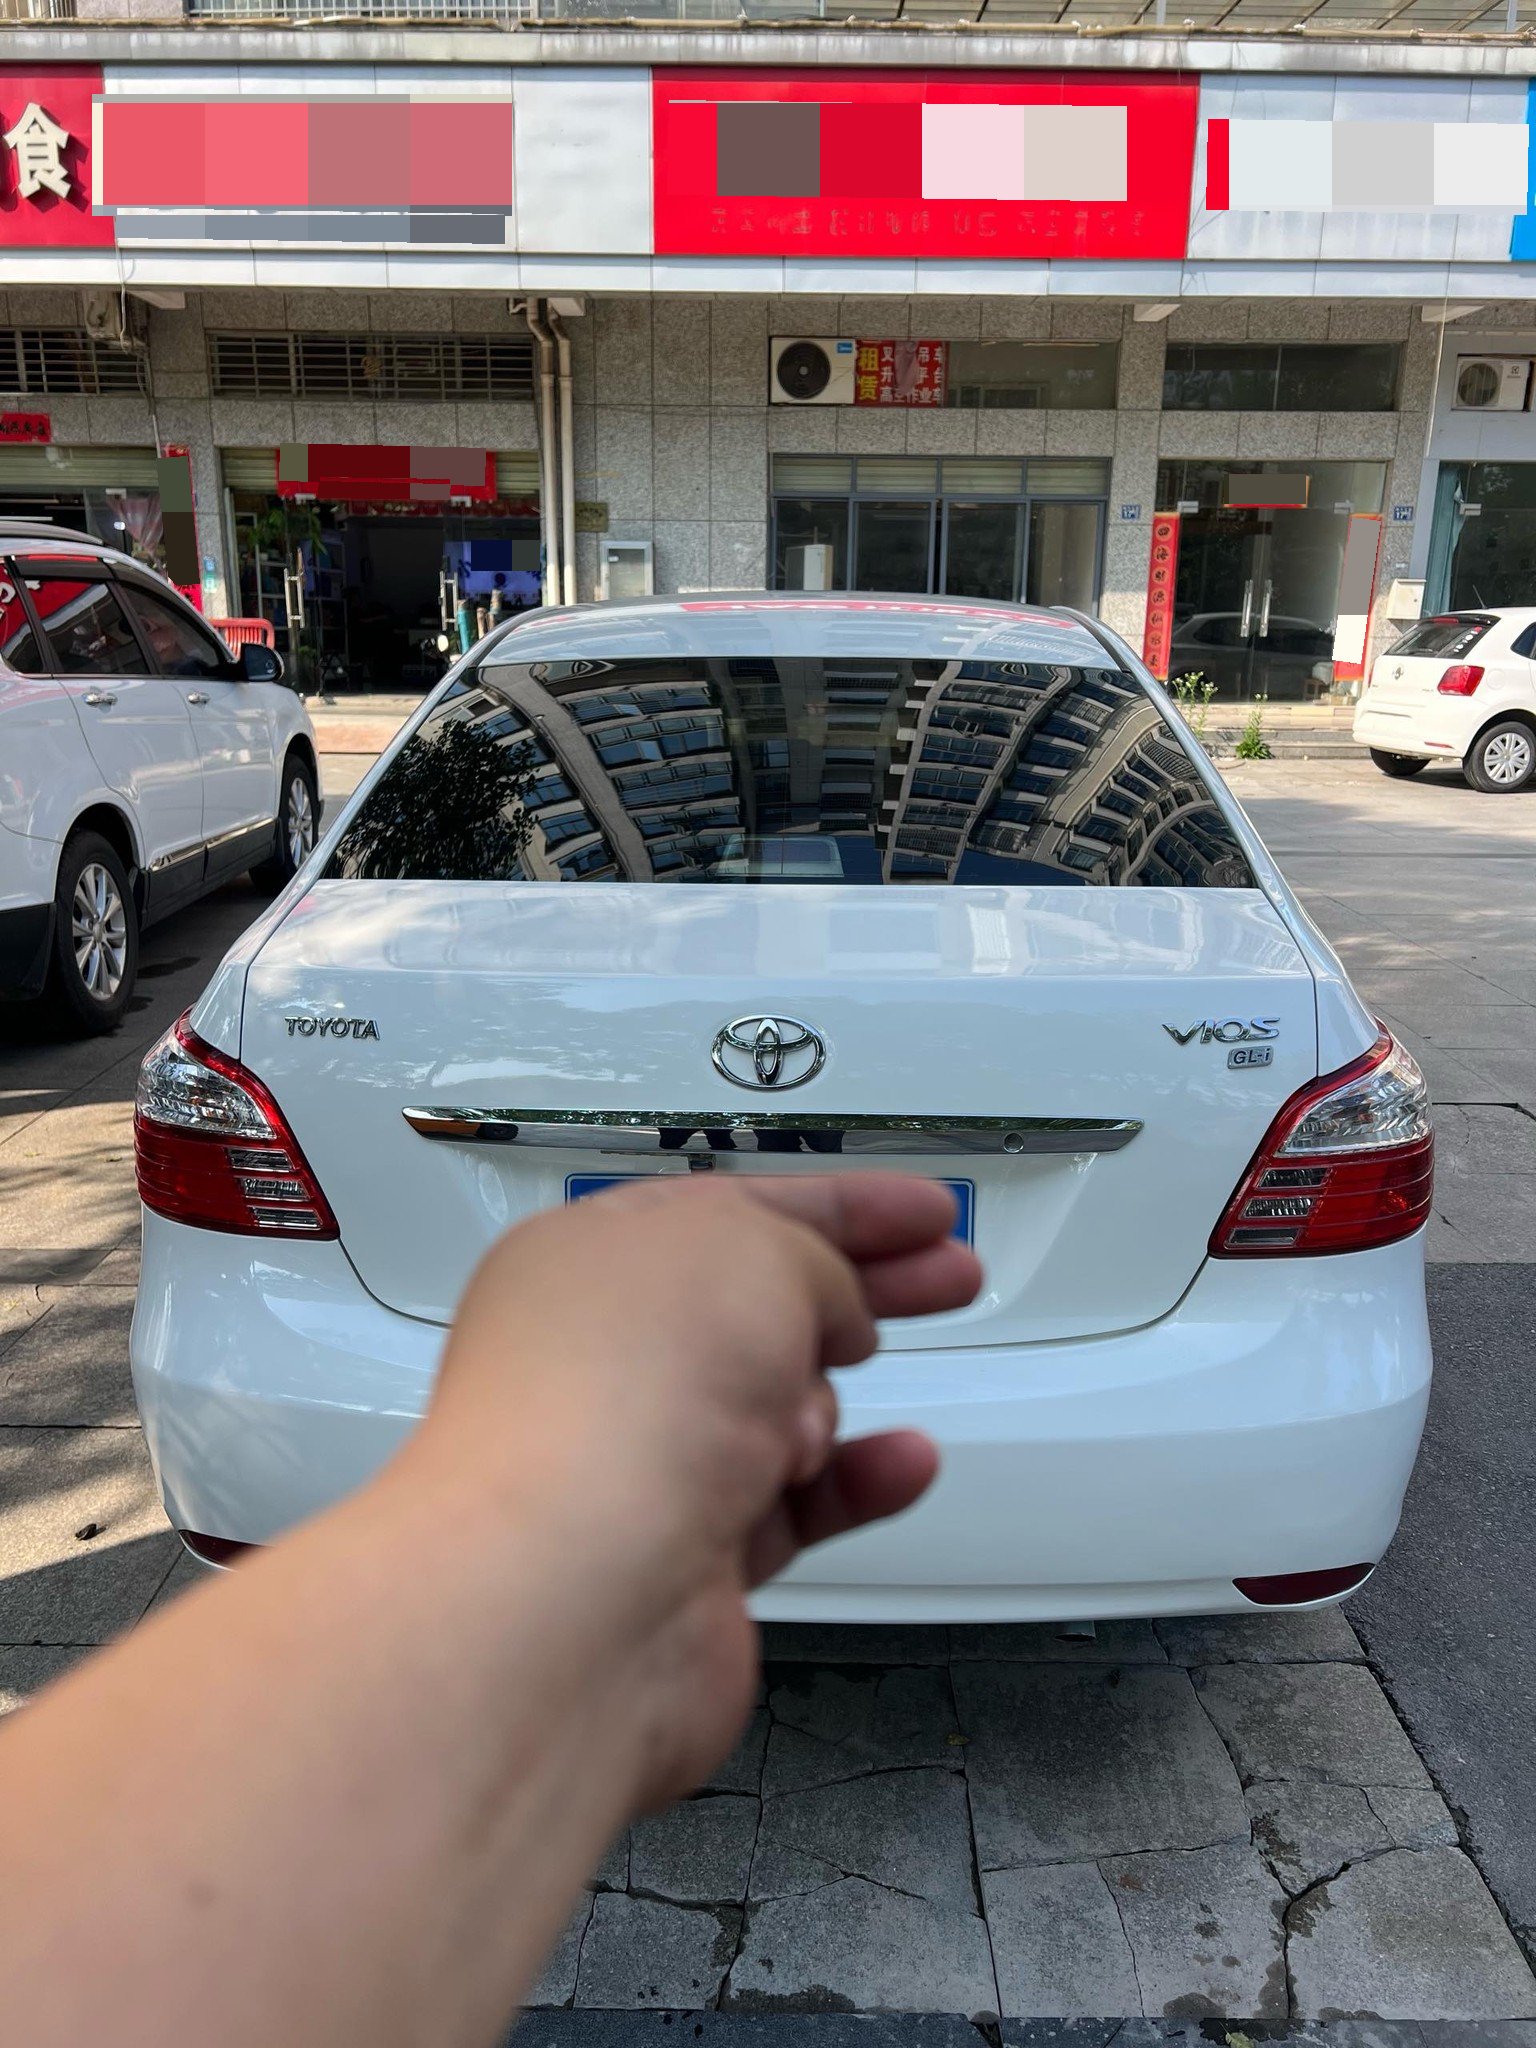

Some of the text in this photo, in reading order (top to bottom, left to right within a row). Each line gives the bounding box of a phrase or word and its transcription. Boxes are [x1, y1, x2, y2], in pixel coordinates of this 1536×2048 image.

[3, 102, 71, 199] 食
[285, 1016, 380, 1040] TOYOTA
[1161, 1016, 1281, 1045] VIOS
